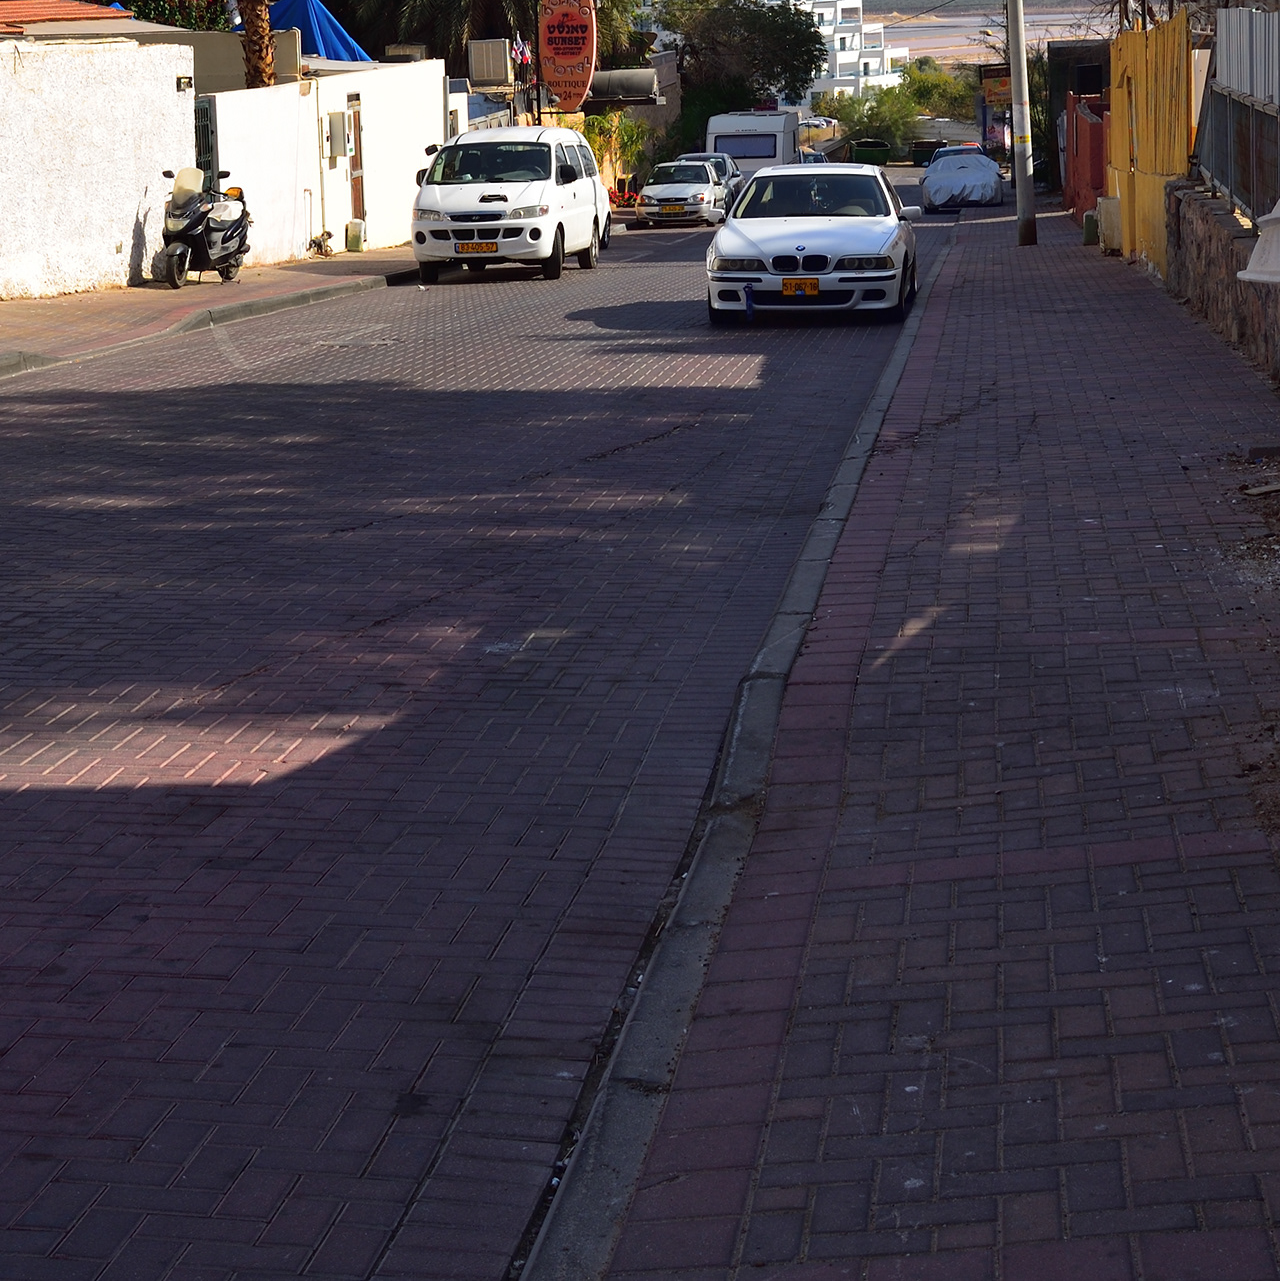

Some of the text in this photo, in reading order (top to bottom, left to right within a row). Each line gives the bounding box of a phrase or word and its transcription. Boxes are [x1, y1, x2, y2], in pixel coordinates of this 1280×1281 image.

[547, 36, 587, 46] SUNSET
[548, 80, 587, 88] BOUTIQUE
[563, 90, 572, 100] 24
